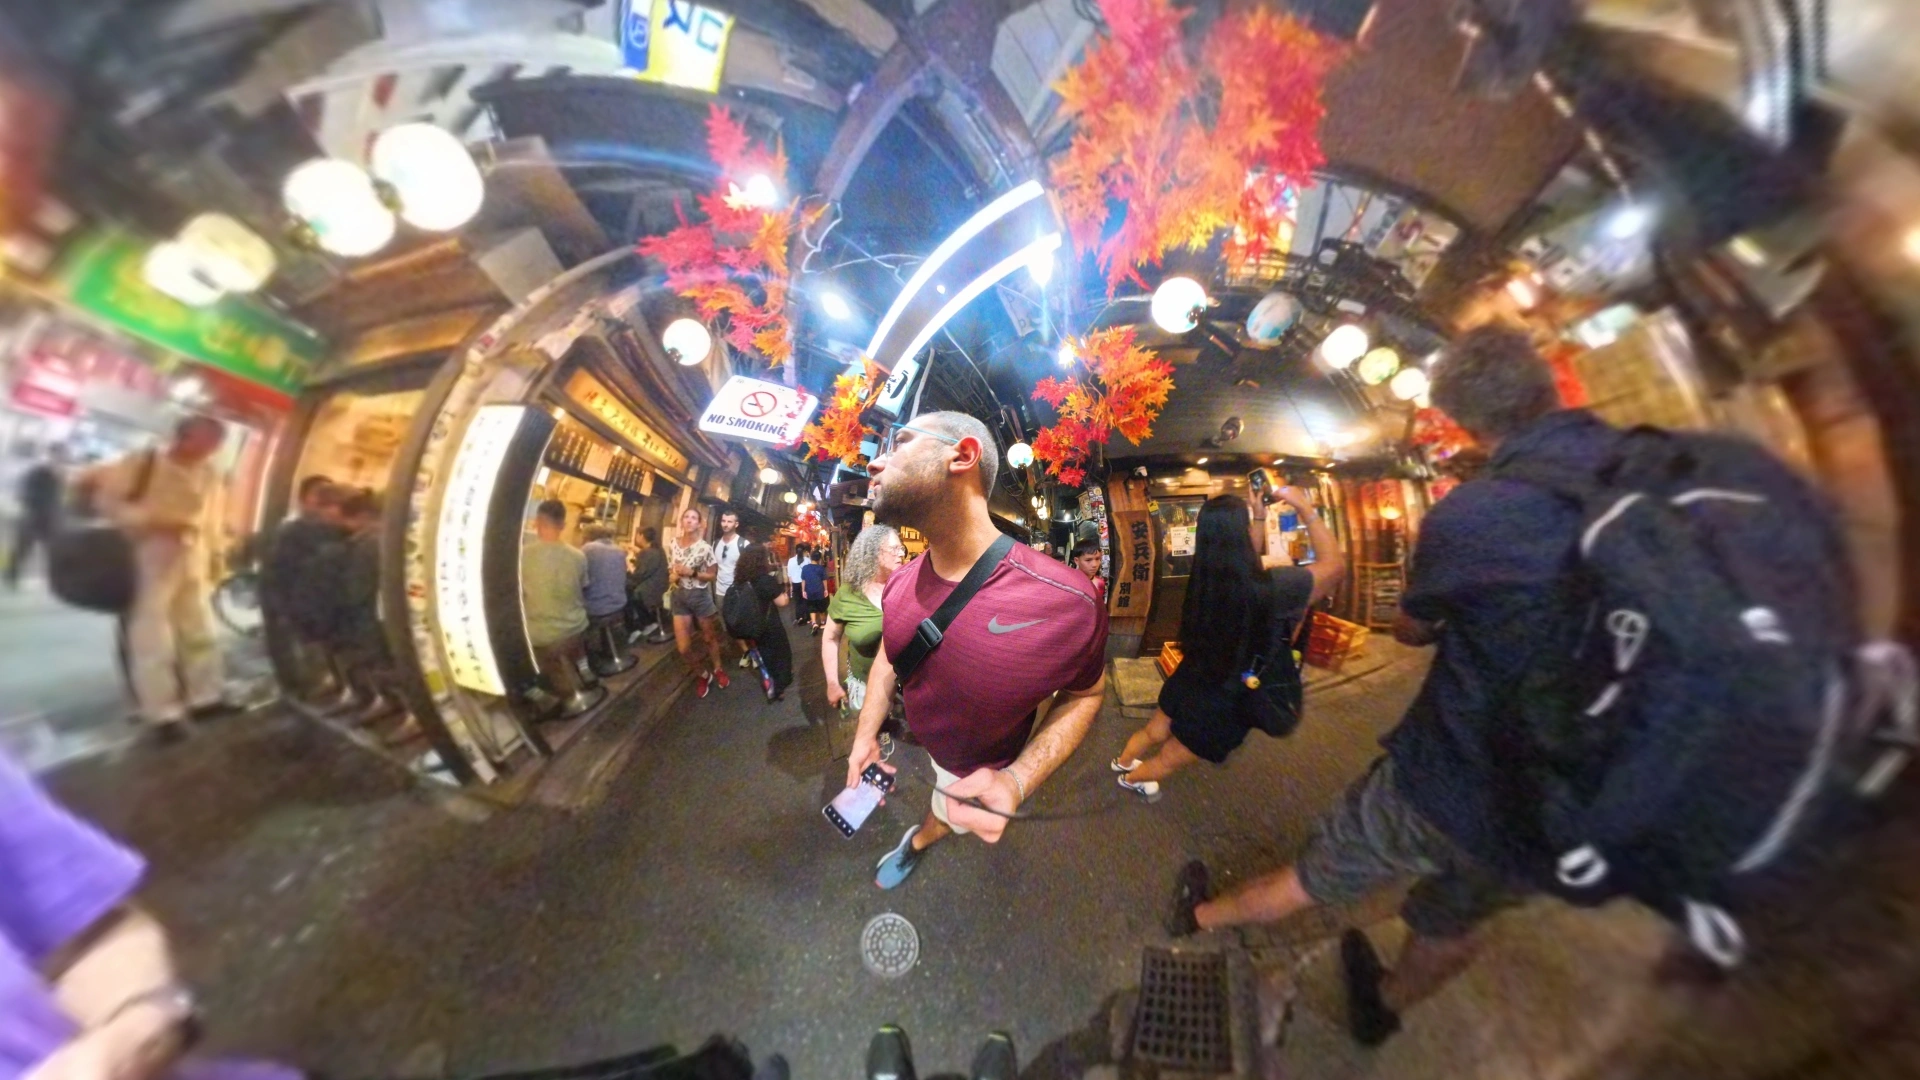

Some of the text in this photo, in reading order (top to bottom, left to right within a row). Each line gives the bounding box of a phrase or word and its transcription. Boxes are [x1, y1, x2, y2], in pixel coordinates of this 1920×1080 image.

[707, 413, 787, 437] NO SMOKING
[1132, 522, 1149, 581] 安兵衛
[1118, 582, 1131, 607] 別館
